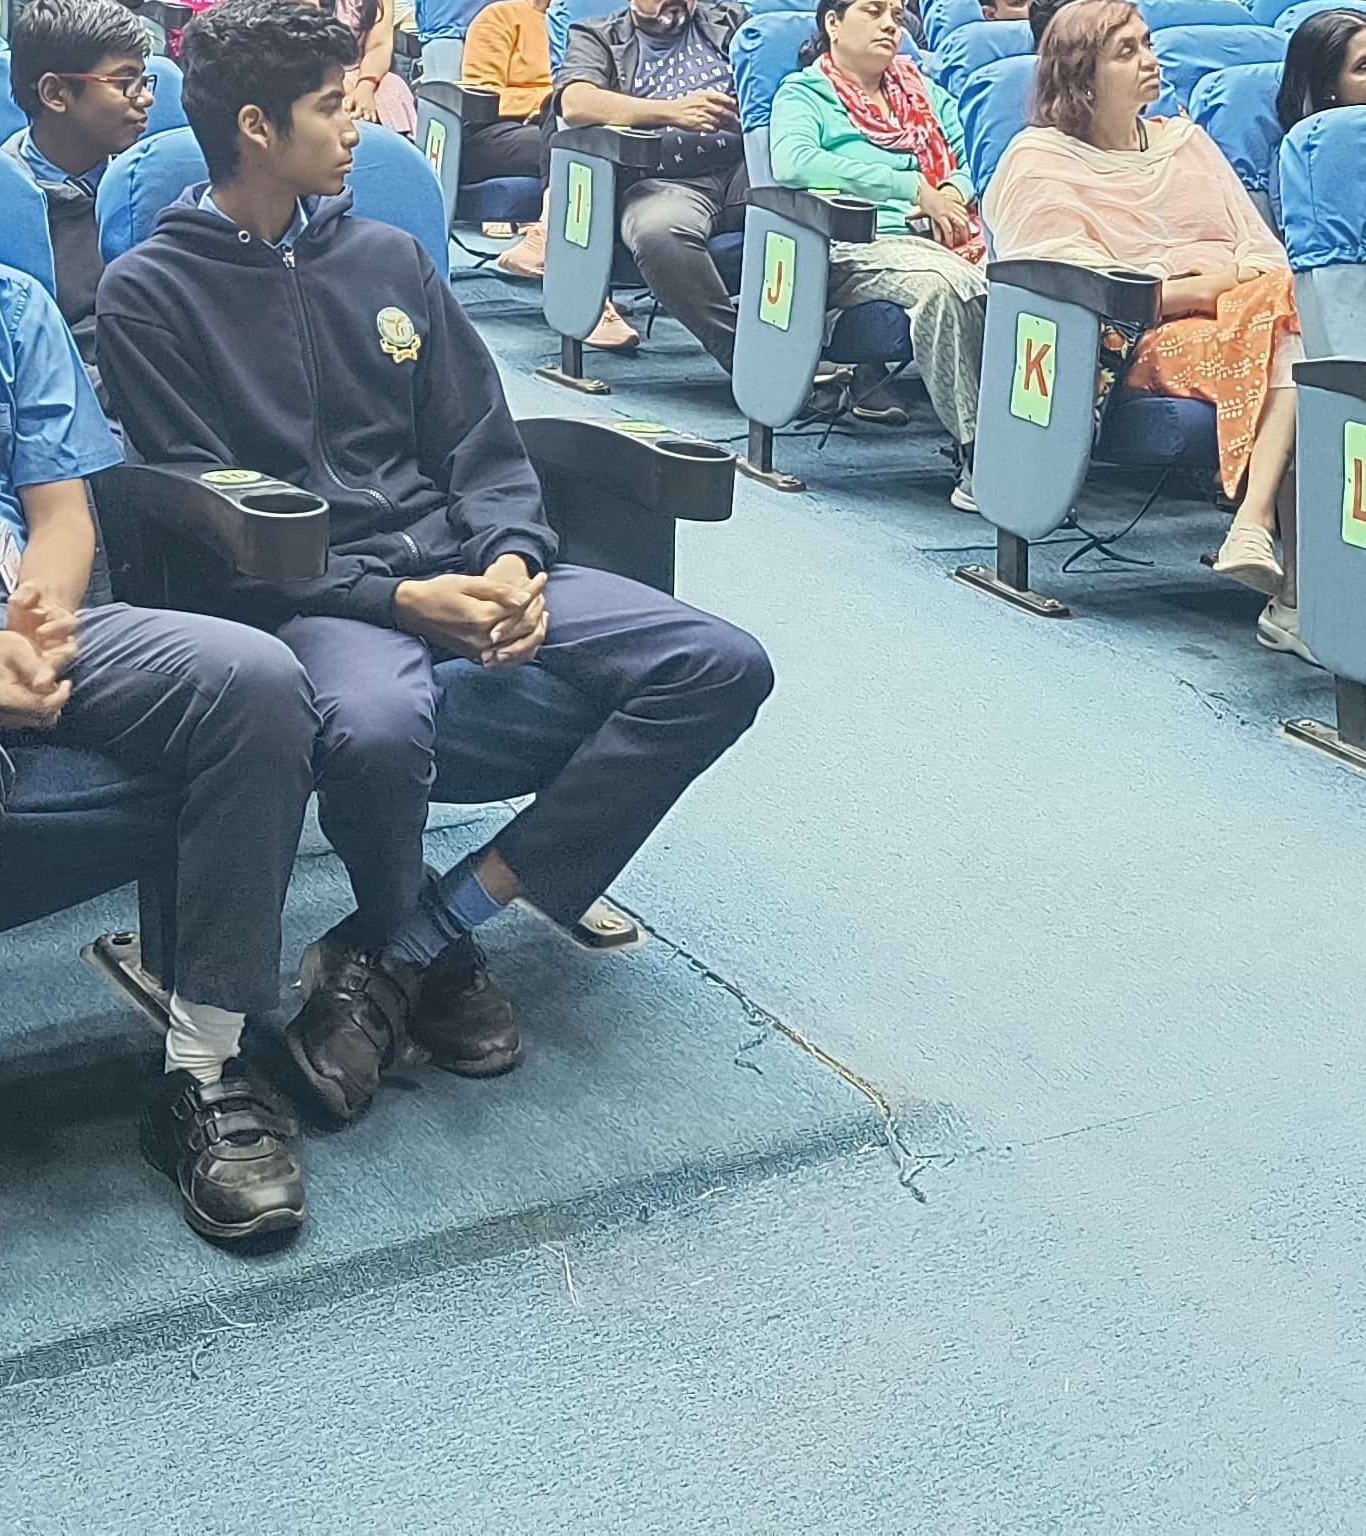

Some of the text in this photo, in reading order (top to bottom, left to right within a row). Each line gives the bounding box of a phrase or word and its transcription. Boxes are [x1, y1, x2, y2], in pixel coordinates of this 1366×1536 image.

[576, 183, 583, 224] I
[767, 260, 783, 305] J
[1023, 338, 1052, 398] K
